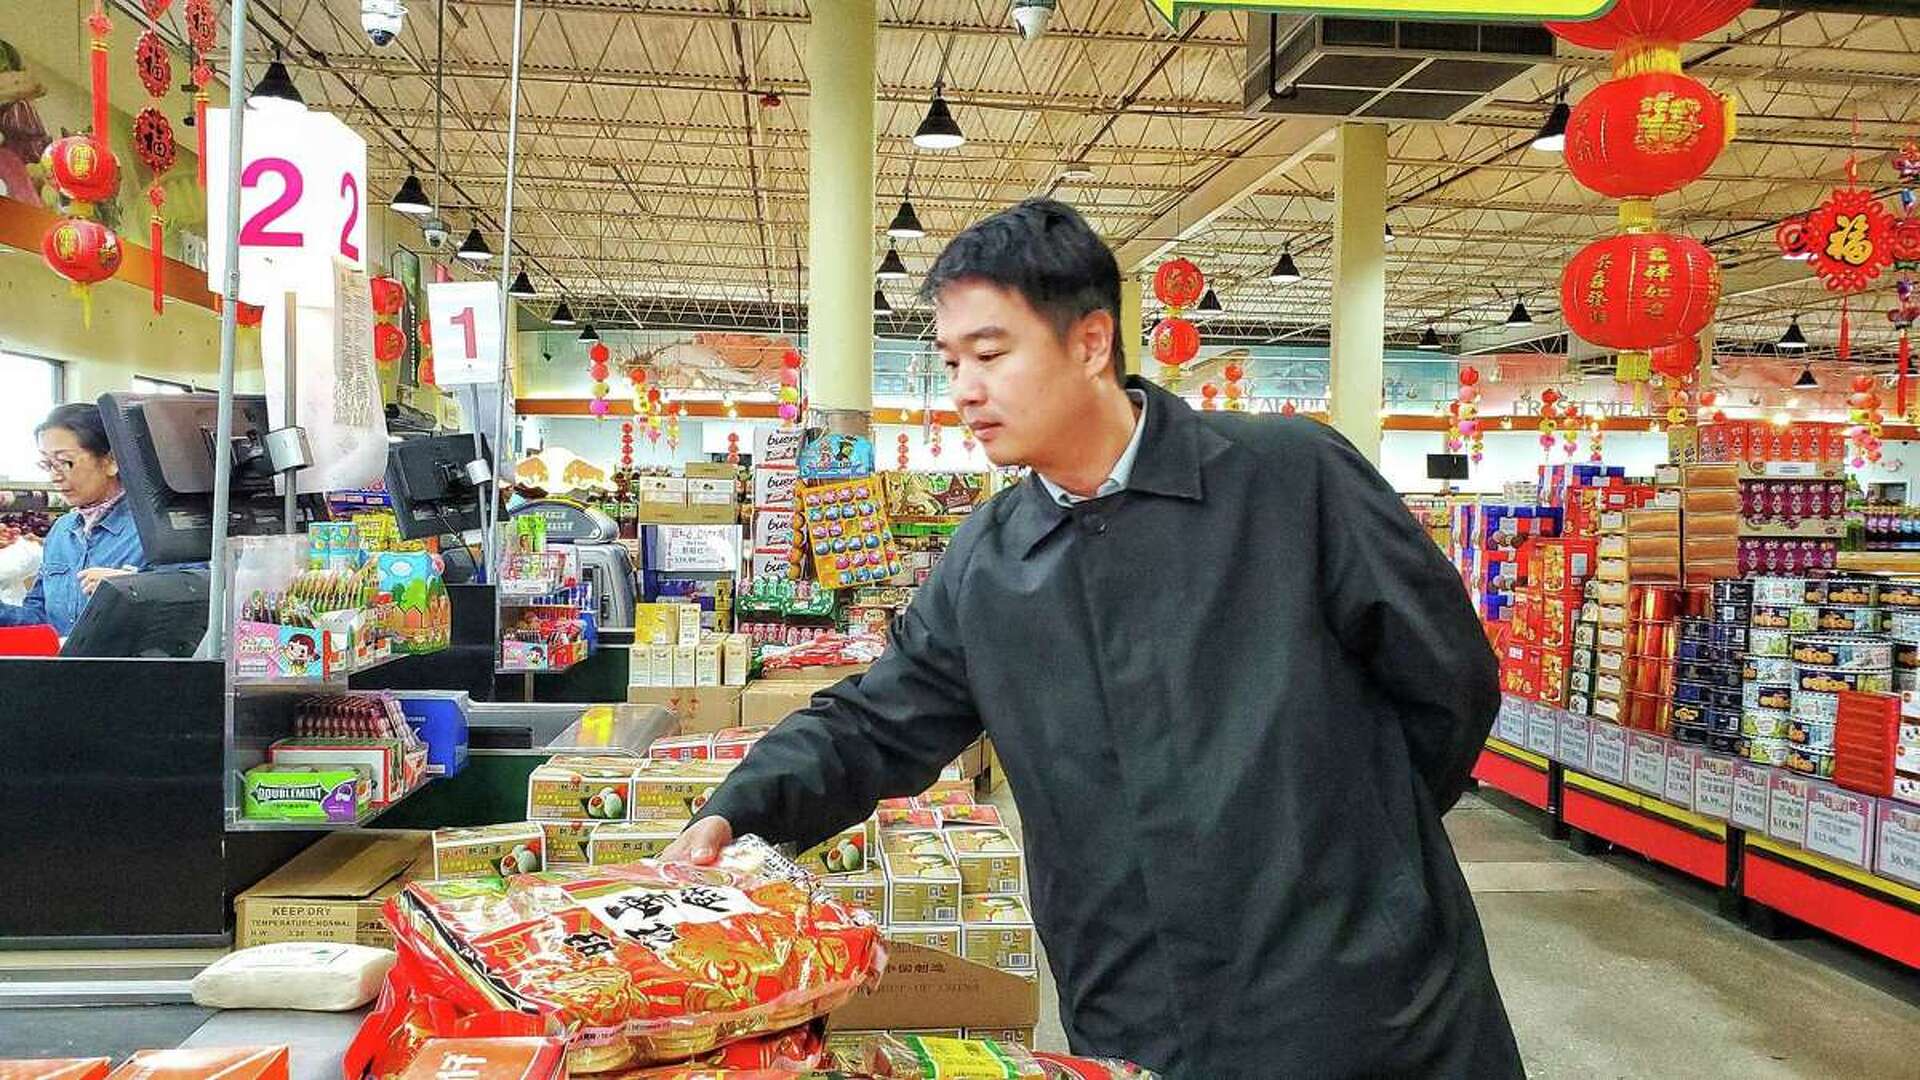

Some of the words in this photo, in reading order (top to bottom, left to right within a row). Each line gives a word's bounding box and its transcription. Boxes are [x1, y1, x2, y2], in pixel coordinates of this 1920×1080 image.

[239, 158, 304, 247] 2
[340, 172, 359, 262] 2
[1826, 213, 1873, 265] 福
[450, 307, 477, 359] 1
[258, 788, 321, 800] DOUBLEMINT
[272, 906, 305, 916] KEEP
[308, 906, 331, 916] DRY
